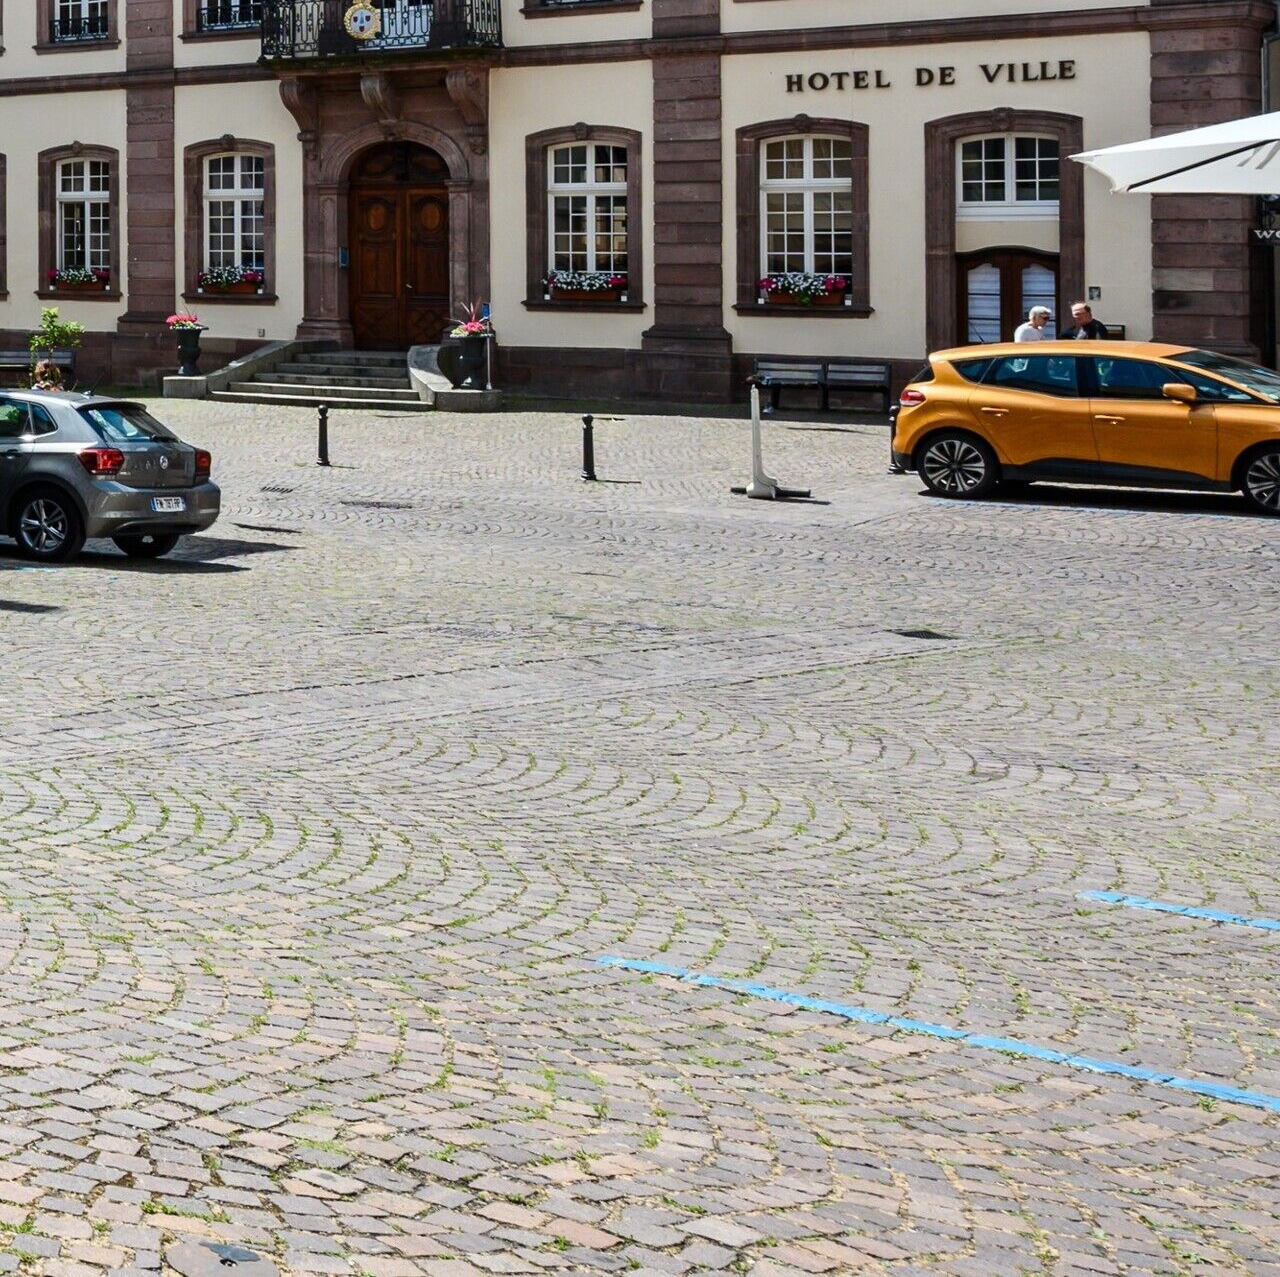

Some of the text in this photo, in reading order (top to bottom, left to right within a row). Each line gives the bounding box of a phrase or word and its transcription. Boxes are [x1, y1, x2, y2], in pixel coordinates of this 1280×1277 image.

[785, 59, 1077, 93] HOTEL DE VILLE
